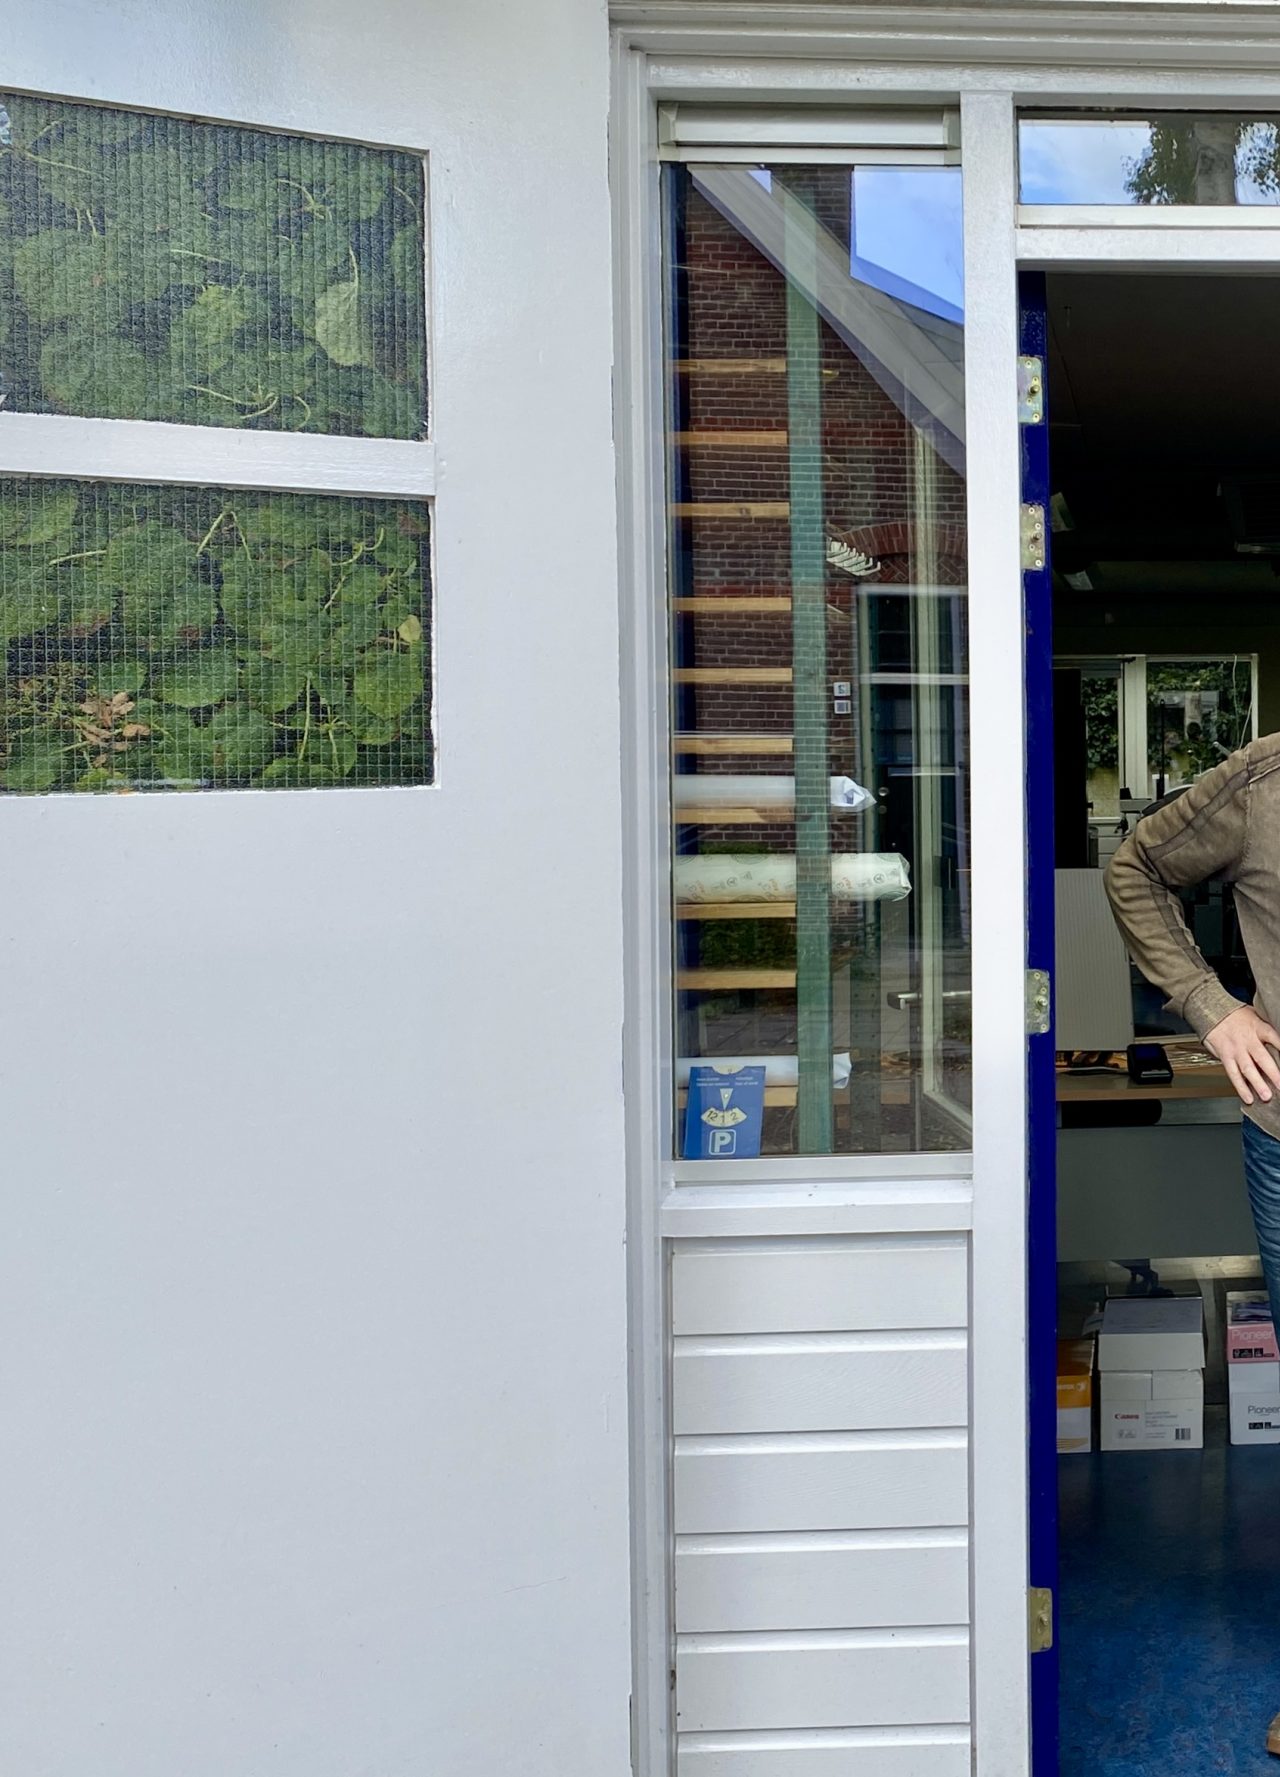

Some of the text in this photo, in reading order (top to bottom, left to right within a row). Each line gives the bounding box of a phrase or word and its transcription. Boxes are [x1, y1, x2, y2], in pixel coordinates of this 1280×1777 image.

[707, 1110, 718, 1121] 12
[714, 1132, 731, 1153] P
[1231, 1329, 1273, 1342] Pioneer
[1247, 1405, 1280, 1415] Pioneer
